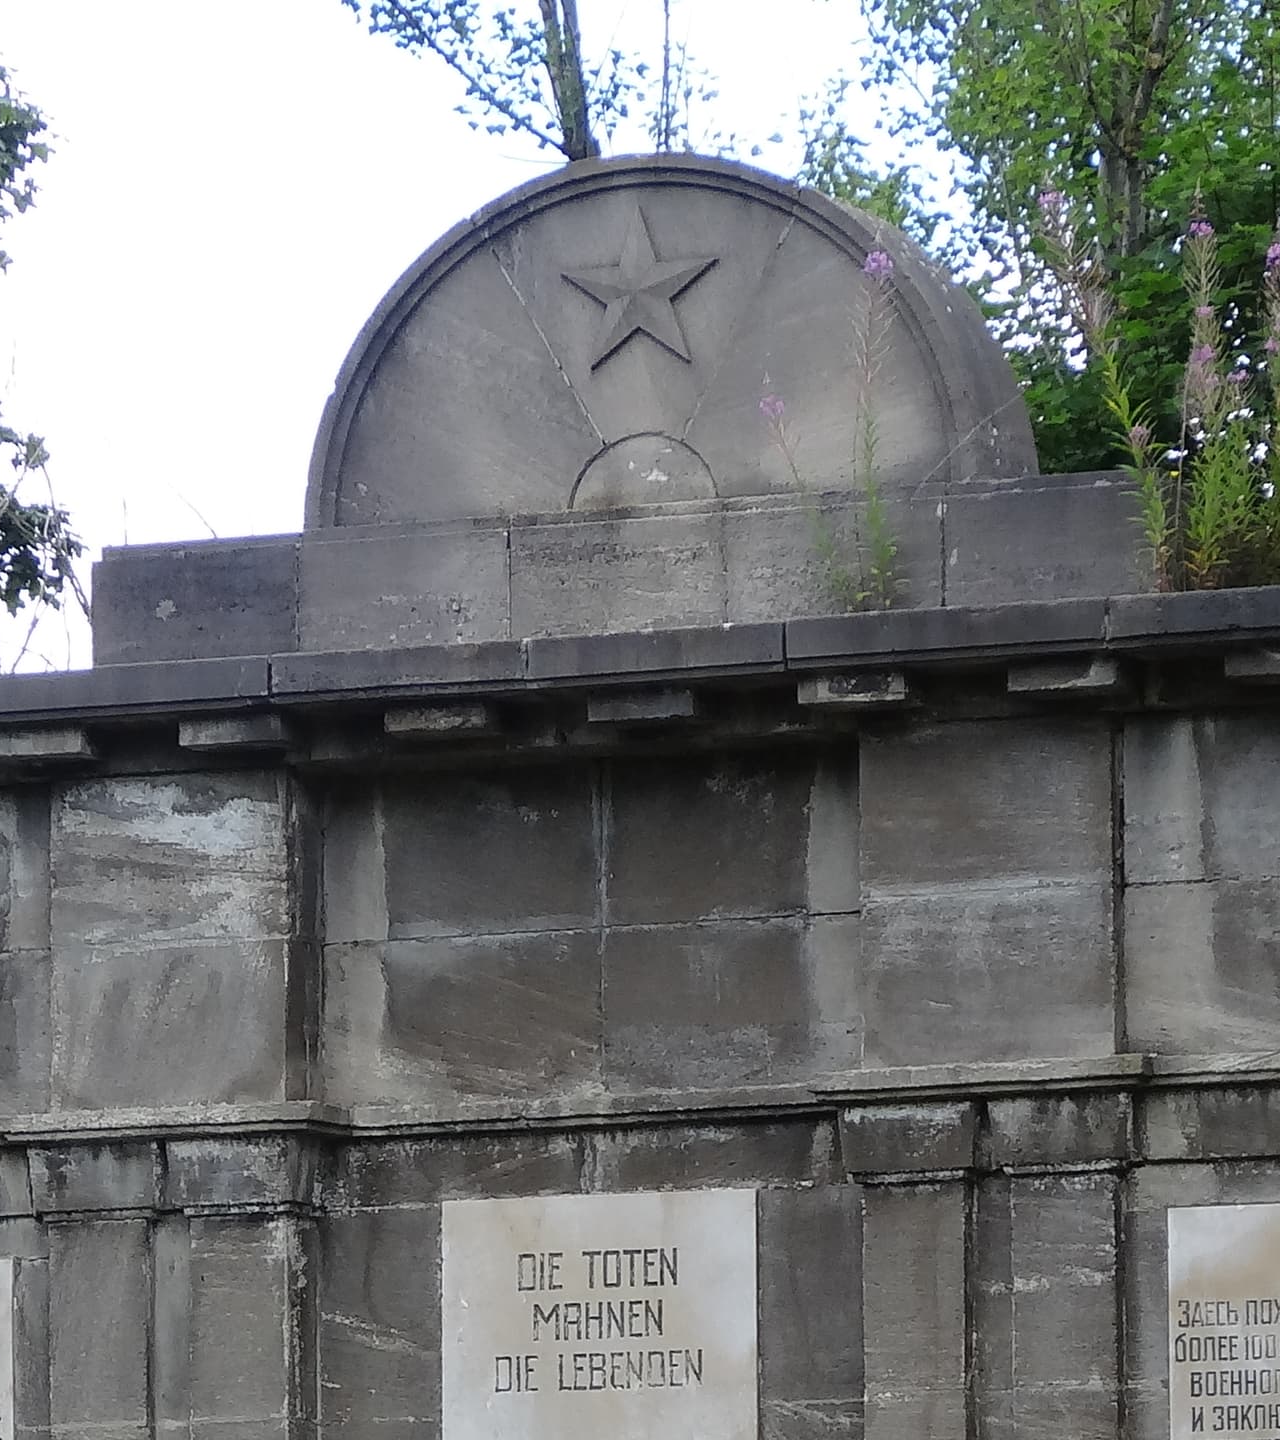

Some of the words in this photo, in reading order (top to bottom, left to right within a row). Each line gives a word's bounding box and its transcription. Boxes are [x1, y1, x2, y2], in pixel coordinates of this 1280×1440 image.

[517, 1252, 564, 1292] DIE
[582, 1247, 678, 1289] TOTEN
[532, 1299, 664, 1342] MAHNEN
[1177, 1299, 1239, 1328] ЗДЕСЬ
[1243, 1334, 1277, 1361] 100
[494, 1355, 539, 1393] DIE
[558, 1349, 704, 1392] LEBENDEN
[1192, 1406, 1204, 1433] И
